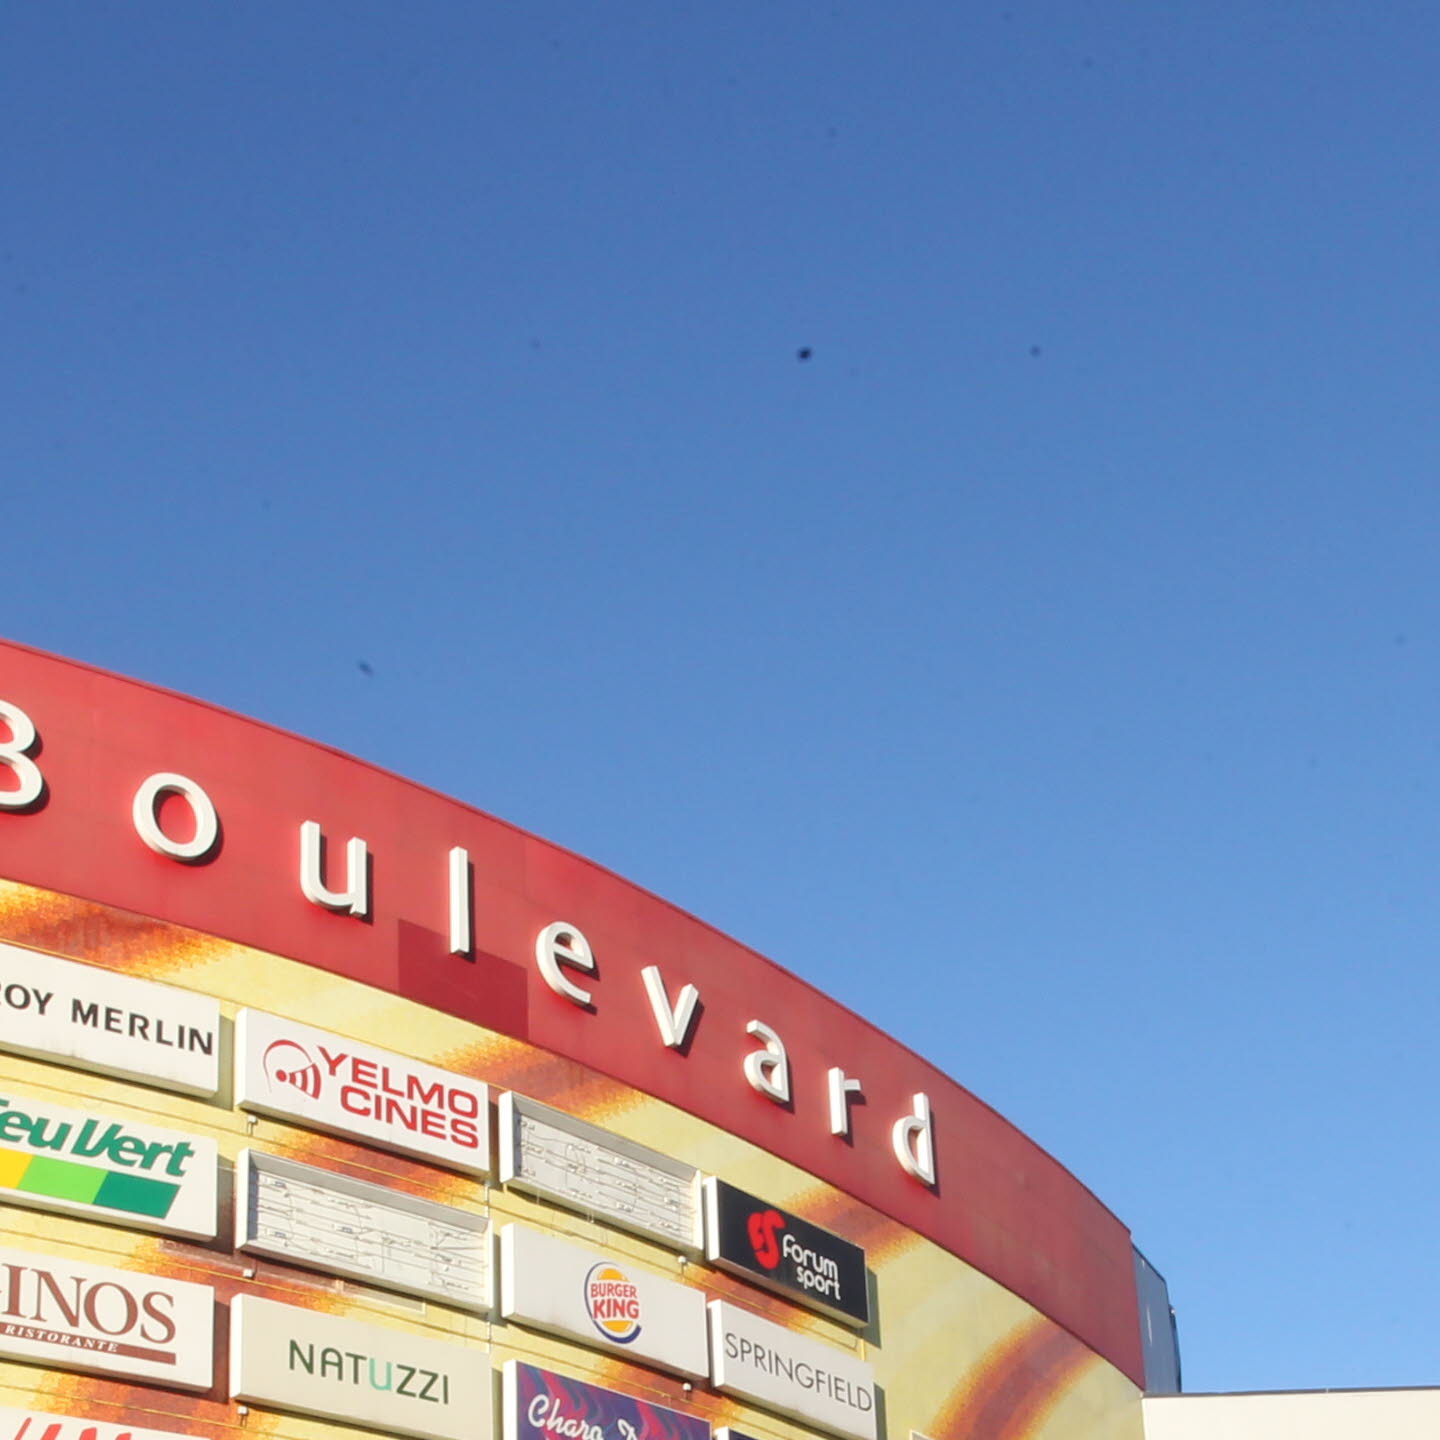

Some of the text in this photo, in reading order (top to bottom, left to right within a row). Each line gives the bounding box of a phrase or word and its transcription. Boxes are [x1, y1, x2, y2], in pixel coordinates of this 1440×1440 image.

[71, 998, 213, 1056] MERLIN
[318, 1046, 480, 1116] YELMO
[340, 1086, 479, 1149] CINES
[590, 1282, 638, 1299] BURGER
[593, 1298, 640, 1320] KING
[796, 1265, 842, 1301] sport
[4, 1323, 119, 1353] RISTORANTE
[289, 1339, 449, 1405] NATUZZI
[724, 1331, 873, 1413] SPRINGFIELD
